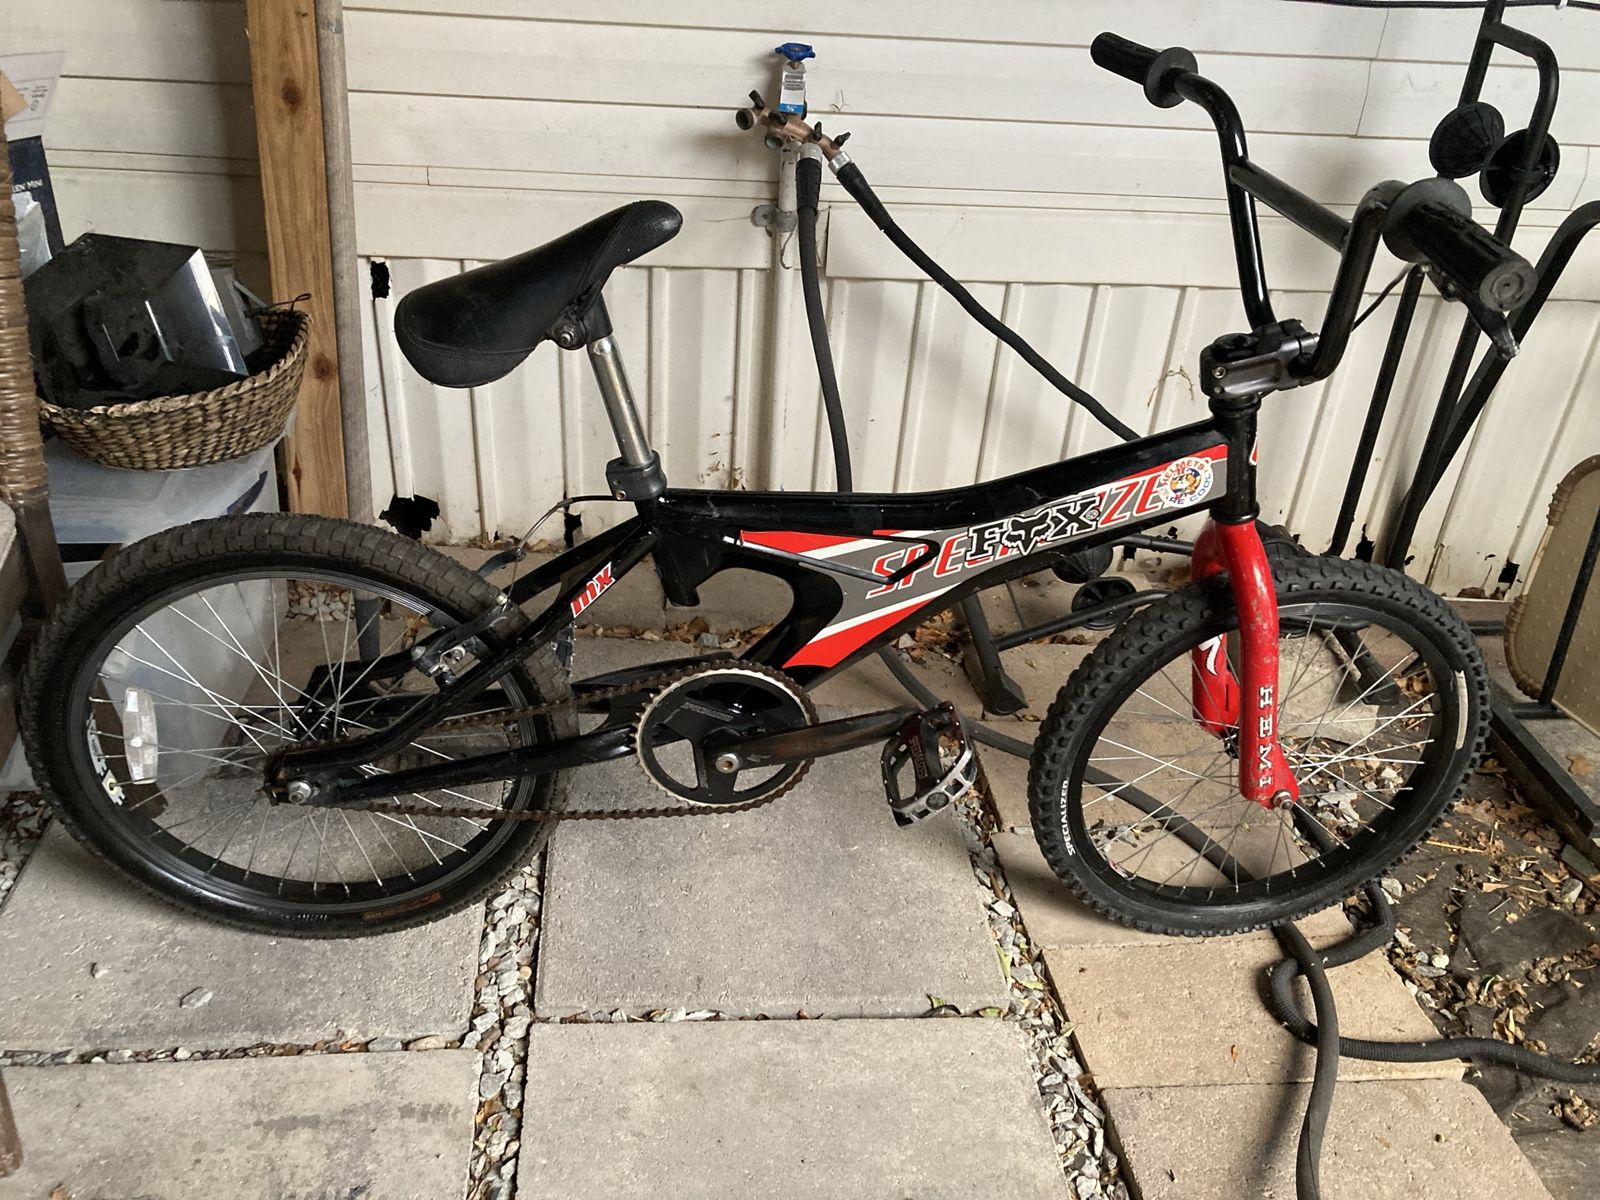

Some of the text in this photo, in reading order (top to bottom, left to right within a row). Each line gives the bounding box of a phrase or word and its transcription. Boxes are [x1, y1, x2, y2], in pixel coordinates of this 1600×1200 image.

[1163, 460, 1205, 486] HELMETS
[1190, 473, 1211, 502] COOL
[1259, 686, 1273, 788] HEMI
[1060, 780, 1076, 856] SPECIALIZED
